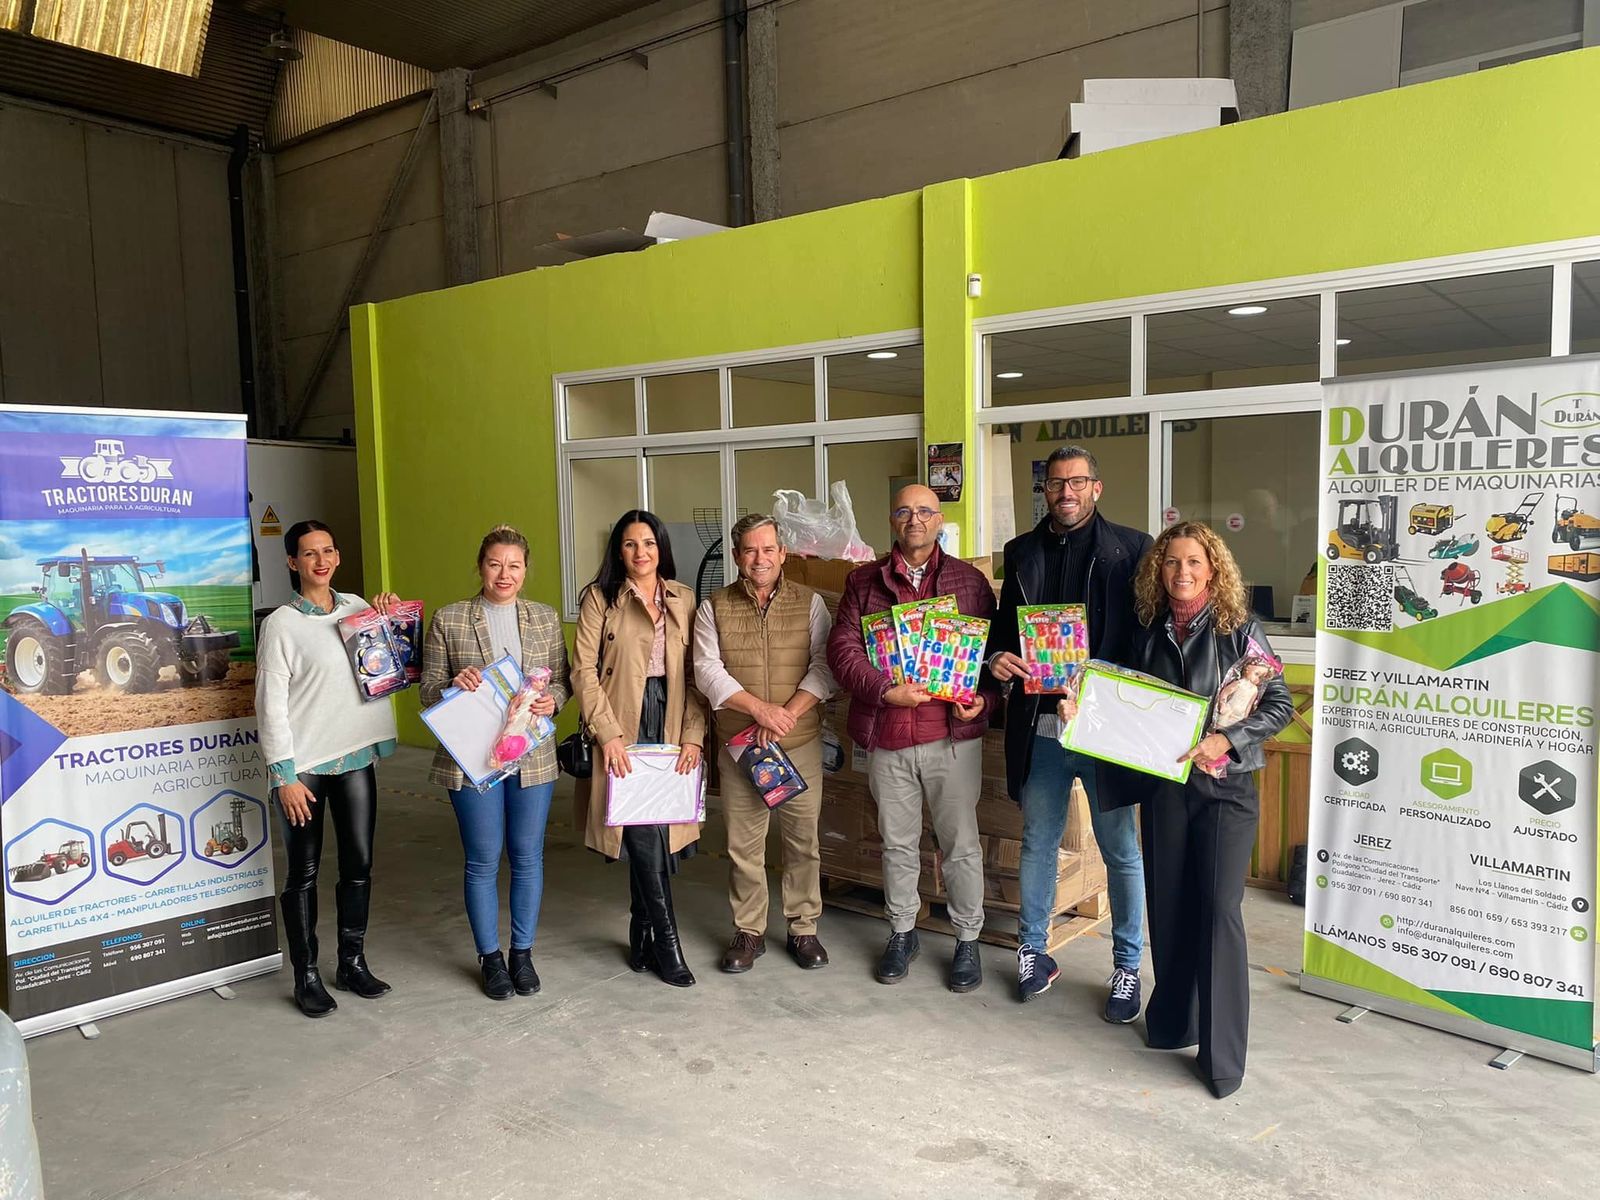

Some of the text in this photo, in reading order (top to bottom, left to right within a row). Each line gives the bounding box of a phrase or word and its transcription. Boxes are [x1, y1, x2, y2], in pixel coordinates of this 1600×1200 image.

[1572, 398, 1582, 409] T
[1328, 386, 1537, 446] DURÁN
[1328, 434, 1600, 476] ALQUILERES
[41, 486, 192, 506] TRACTORES DURAN
[1328, 478, 1418, 494] ALQUILER
[1424, 477, 1450, 492] DE
[58, 504, 104, 514] MAQUINARIA
[135, 504, 181, 514] AGRICULTURA
[1324, 668, 1489, 691] JEREZ Y VILLAMARTIN
[1323, 684, 1594, 728] DURÁN ALQUILERES
[1322, 705, 1584, 742] EXPERTOS EN ALQUILERES DE CONSTRUCCIÓN,
[1322, 717, 1594, 755] INDUSTRIA, AGRICULTURA, JARDINERÍA Y HOGAR
[54, 728, 258, 770] TRACTORES DURÁN
[85, 750, 260, 787] MAQUINARIA PARA LA
[152, 768, 262, 794] AGRICULTURA
[1324, 795, 1386, 812] CERTIFICADA
[1338, 790, 1370, 800] CALIDAD
[1400, 807, 1492, 829] PERSONALIZADO
[1412, 800, 1480, 816] ASESORAMIENTO
[1513, 826, 1578, 842] AJUSTADO
[1529, 817, 1561, 828] PRECIO
[1354, 834, 1392, 850] JEREZ
[1364, 858, 1419, 874] Comunicaciones
[1388, 869, 1398, 878] del
[1470, 854, 1571, 882] VILLAMARTIN
[1377, 876, 1396, 886] Jerez
[1478, 879, 1567, 902] Los Llanos del Soldado
[10, 908, 62, 927] ALQUILER
[64, 906, 77, 916] DE
[79, 894, 136, 912] TRACTORES
[145, 880, 206, 899] CARRETILLAS
[207, 867, 268, 886] INDUSTRIALES
[1331, 881, 1346, 890] 956
[1348, 883, 1361, 892] 307
[1362, 888, 1376, 896] 091
[1385, 892, 1400, 900] 690
[1402, 895, 1416, 904] 807
[1418, 898, 1432, 907] 341
[1456, 884, 1474, 892] Nave
[1546, 901, 1568, 911] Cádiz
[18, 917, 87, 938] CARRETILLAS
[90, 912, 108, 922] 4X4
[118, 893, 198, 917] MANIPULADORES
[180, 918, 206, 928] ONLINE
[1450, 905, 1466, 914] 856
[1468, 909, 1482, 918] 001
[1486, 912, 1502, 922] 659
[1511, 918, 1528, 928] 653
[1531, 922, 1548, 932] 393
[1550, 926, 1568, 936] 217
[1397, 916, 1516, 949] http://duranalquileres.com
[1398, 926, 1514, 960] info@duranalquileres.com
[1314, 922, 1584, 997] LLÁMANOS 956 307 091 / 690 807 341
